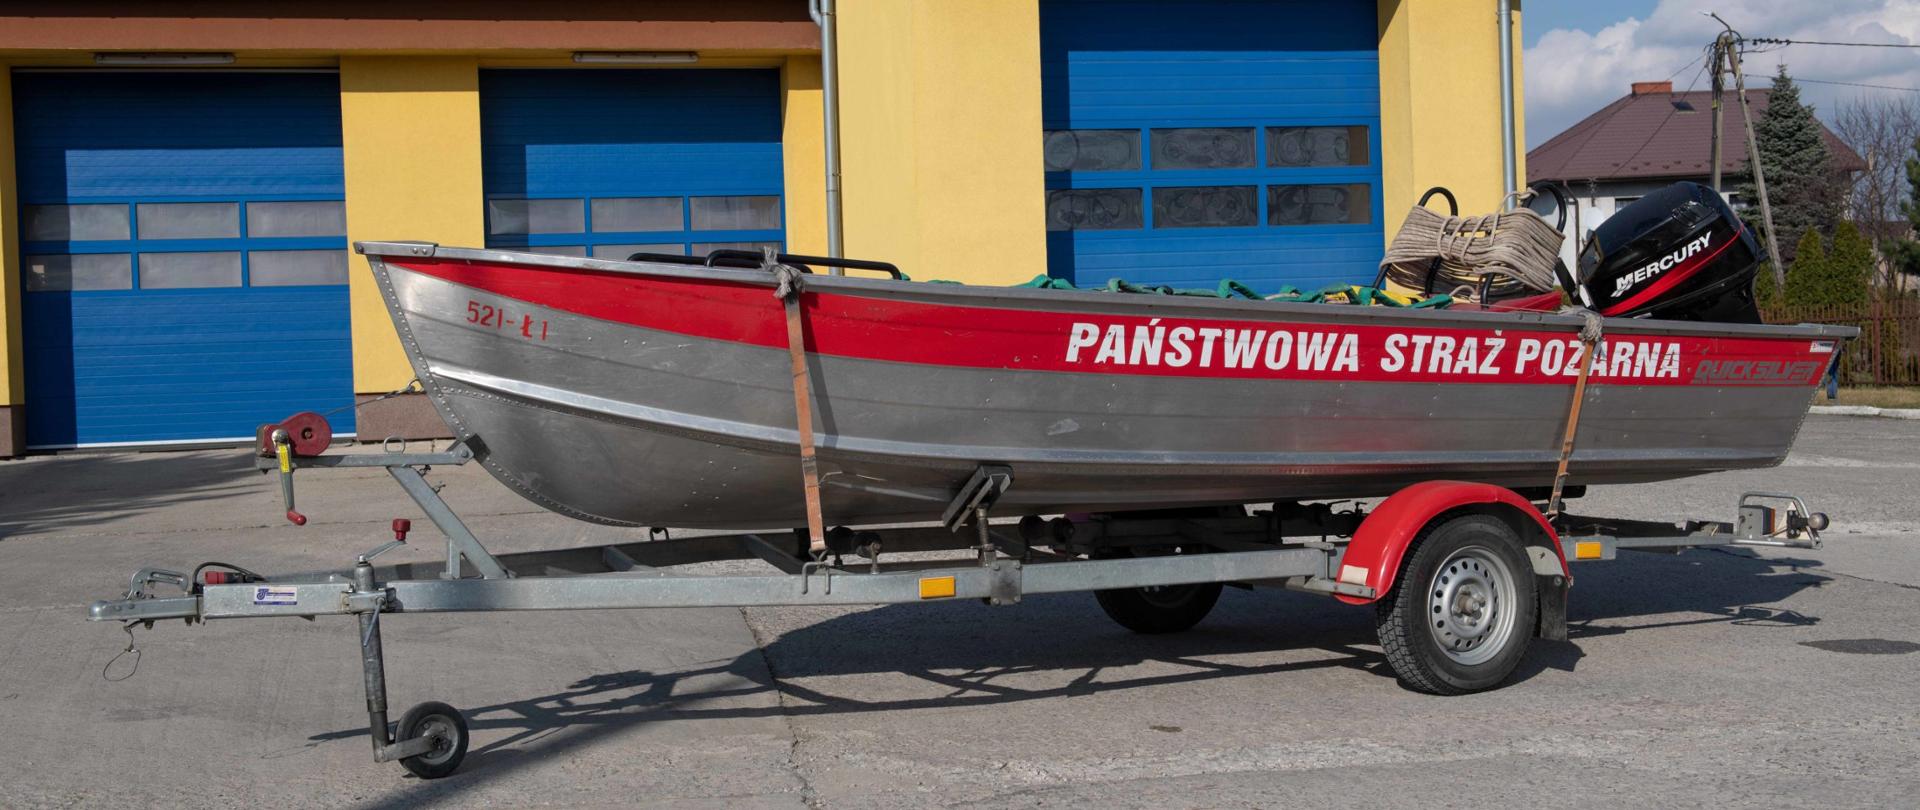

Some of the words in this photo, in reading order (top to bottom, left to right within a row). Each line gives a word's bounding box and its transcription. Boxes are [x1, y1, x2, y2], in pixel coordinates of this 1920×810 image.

[1610, 231, 1712, 298] MERCURY
[1064, 318, 1360, 372] PAŃSTWOWA
[1380, 329, 1507, 375] STRAŻ
[1692, 359, 1822, 383] QUICKSILVER
